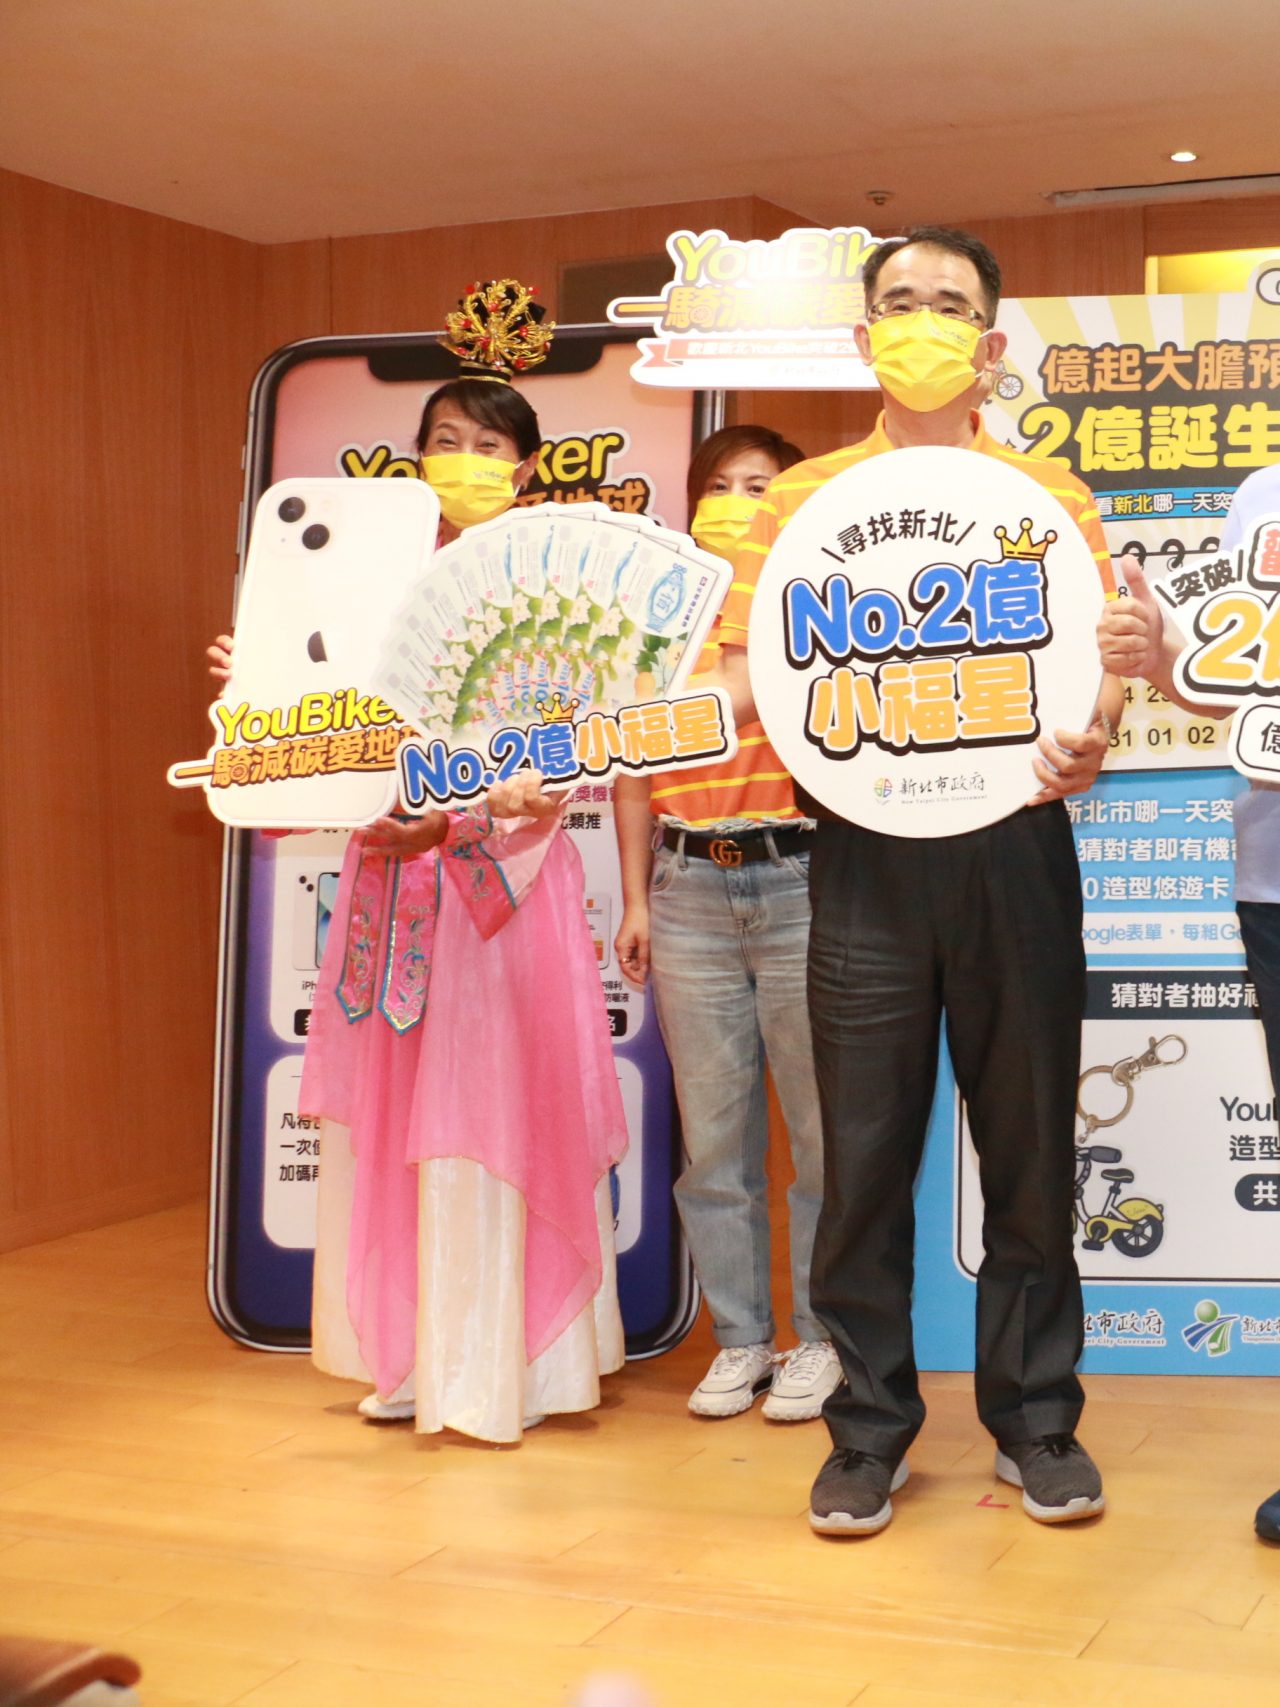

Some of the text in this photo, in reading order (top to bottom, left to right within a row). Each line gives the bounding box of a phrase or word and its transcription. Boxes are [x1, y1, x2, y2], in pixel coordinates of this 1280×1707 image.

[837, 508, 958, 555] 尋找新北
[1171, 558, 1236, 605] 突破
[785, 560, 1050, 667] No.2億
[216, 688, 404, 746] YouBike
[806, 653, 1039, 758] 小福星
[1148, 728, 1172, 745] 01
[1188, 726, 1215, 744] 02
[899, 771, 985, 797] 新北市政府
[1078, 837, 1237, 862] 猜對者即有機
[1219, 1096, 1279, 1122] You
